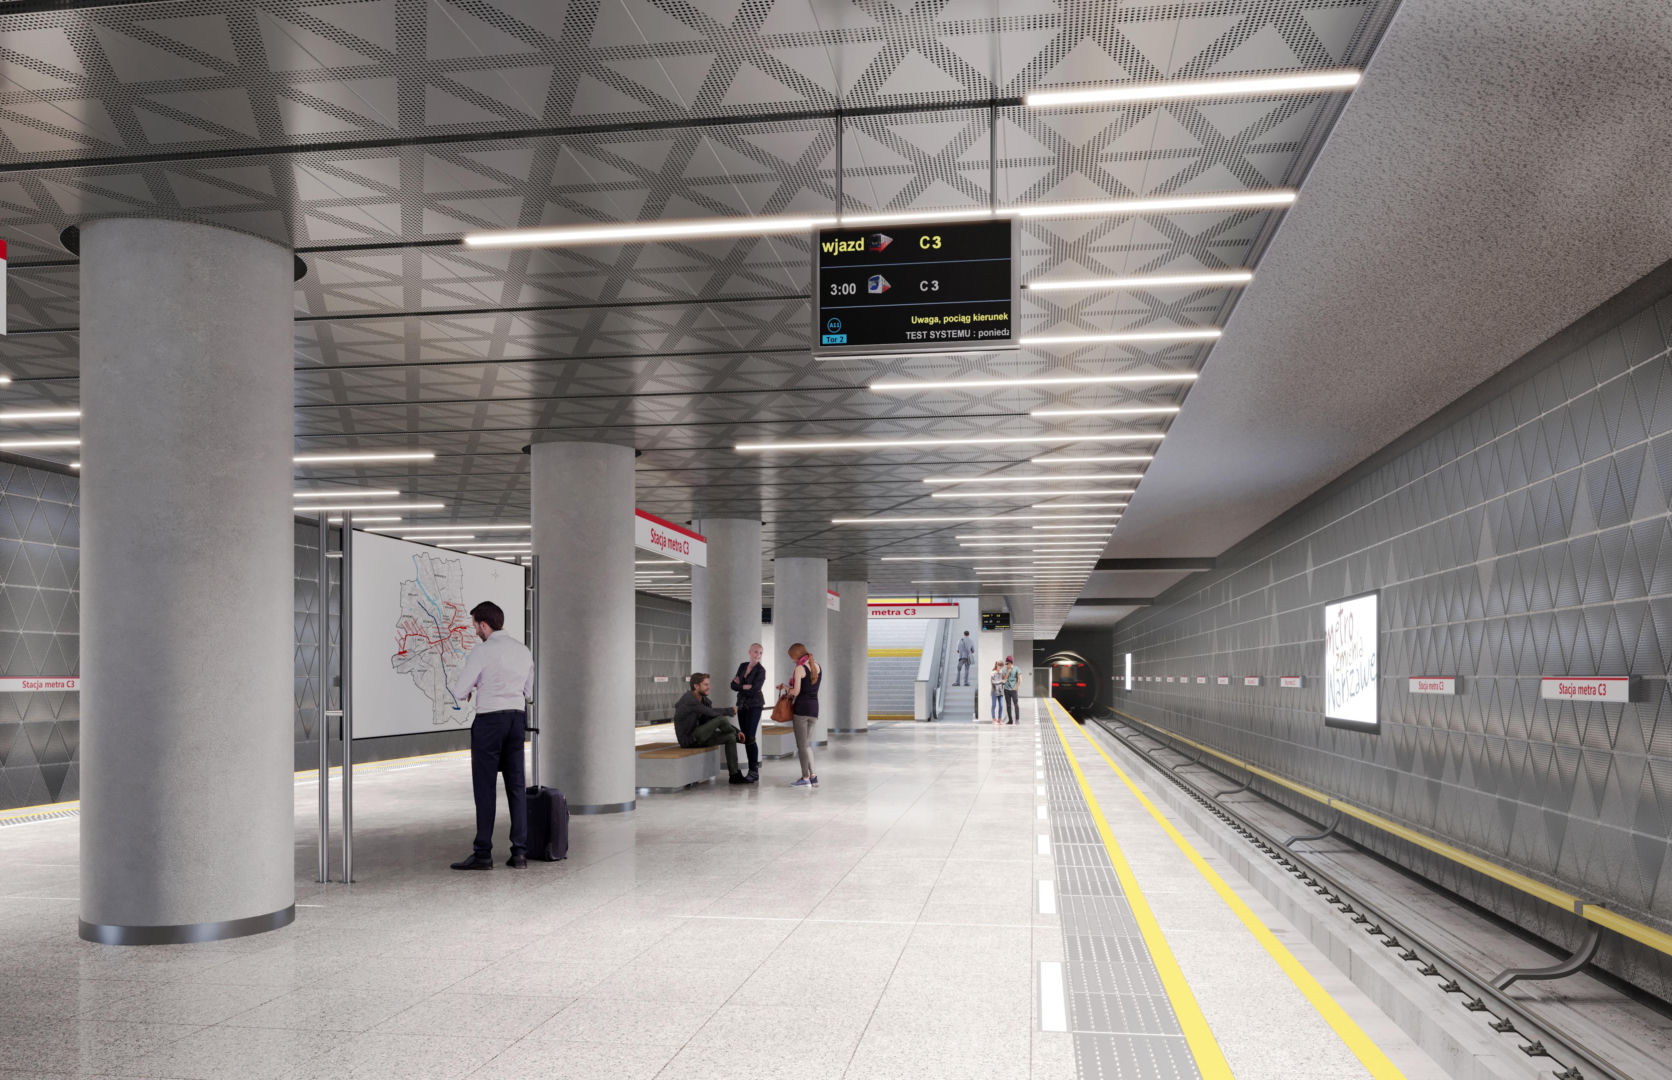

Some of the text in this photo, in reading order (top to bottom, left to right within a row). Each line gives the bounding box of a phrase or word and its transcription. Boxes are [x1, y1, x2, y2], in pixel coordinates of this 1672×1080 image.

[822, 237, 865, 256] wjazd
[830, 283, 857, 296] 3:00
[911, 312, 1009, 325] Uwaga, pociąg kierunek
[906, 331, 928, 340] TEST
[929, 329, 971, 339] SYSTEMU
[650, 528, 689, 555] Stacja metra C3
[903, 608, 917, 616] C3
[22, 680, 43, 690] Stacja
[66, 680, 75, 688] C3
[1418, 681, 1444, 691] Stacja metra C3
[1558, 682, 1607, 698] Stacja metra C3
